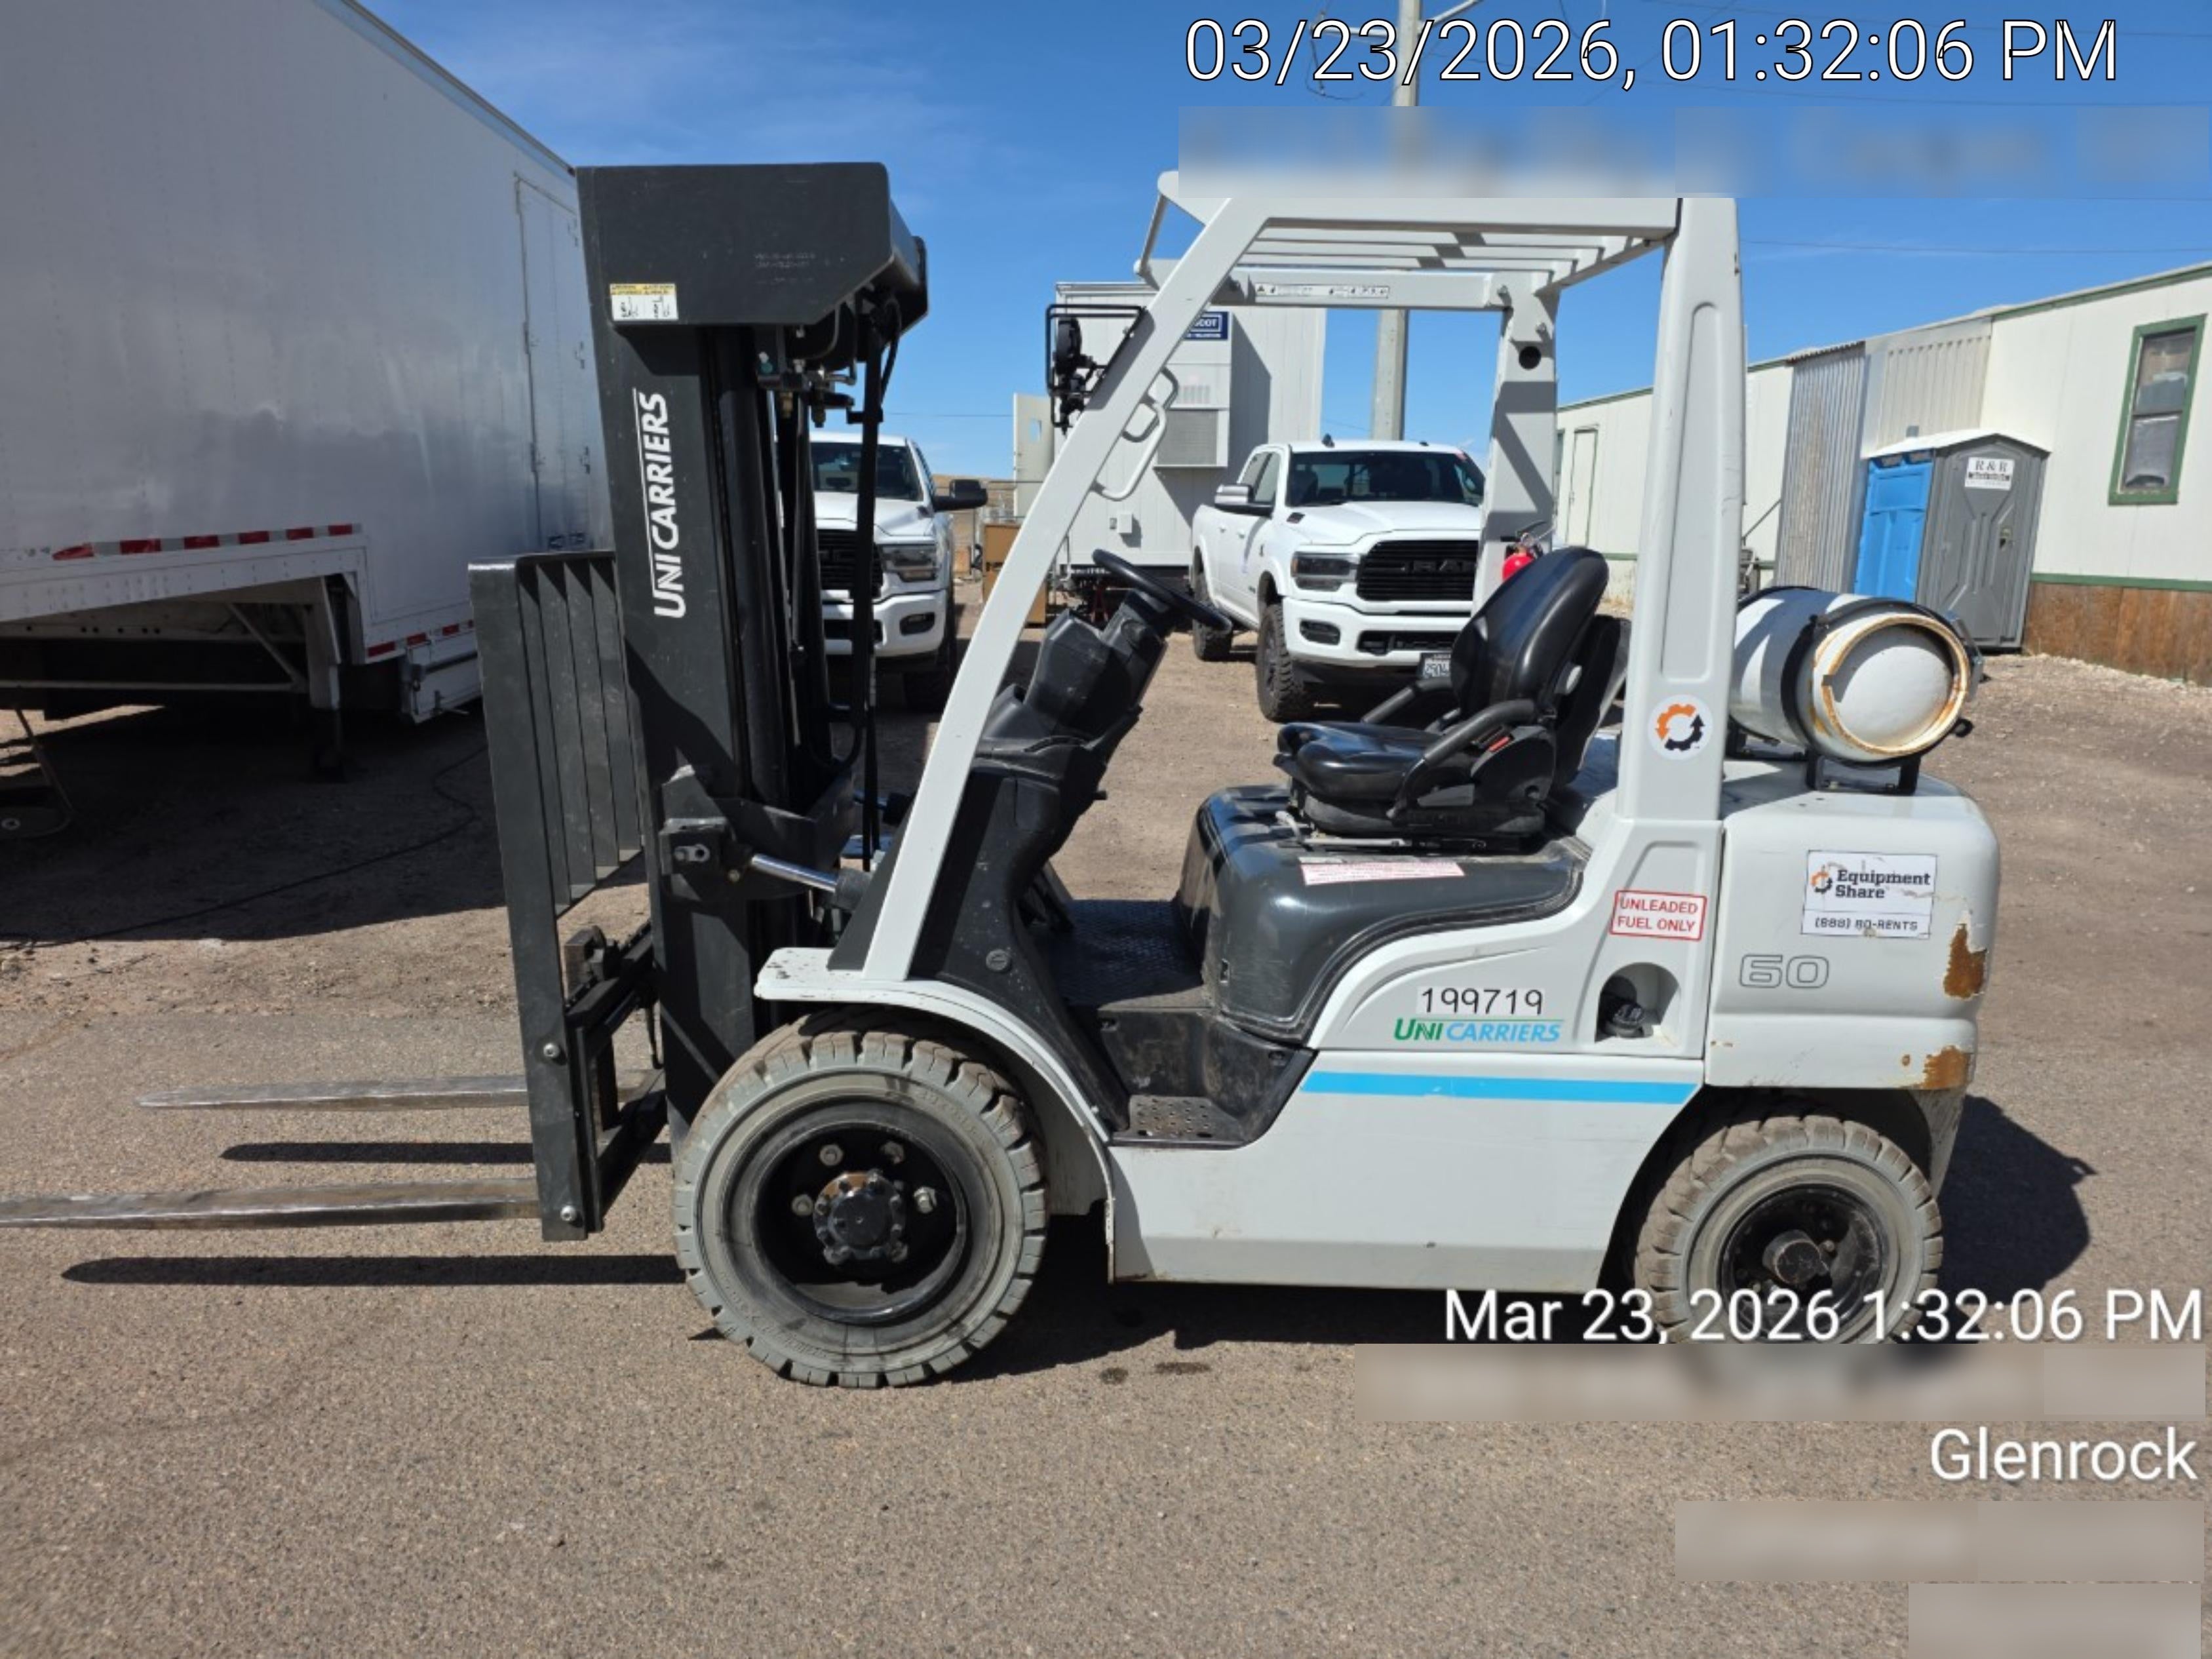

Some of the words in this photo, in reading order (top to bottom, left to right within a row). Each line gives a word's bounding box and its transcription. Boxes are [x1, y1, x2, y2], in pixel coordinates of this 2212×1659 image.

[1836, 869, 1931, 886] Equipment
[1834, 885, 1885, 899] Share
[1620, 897, 1698, 914] UNLEADED
[1618, 916, 1652, 929] FUEL
[1656, 918, 1696, 931] ONLY
[1815, 918, 1852, 929] (888)
[1739, 954, 1830, 989] 60
[1421, 987, 1543, 1015] 199719
